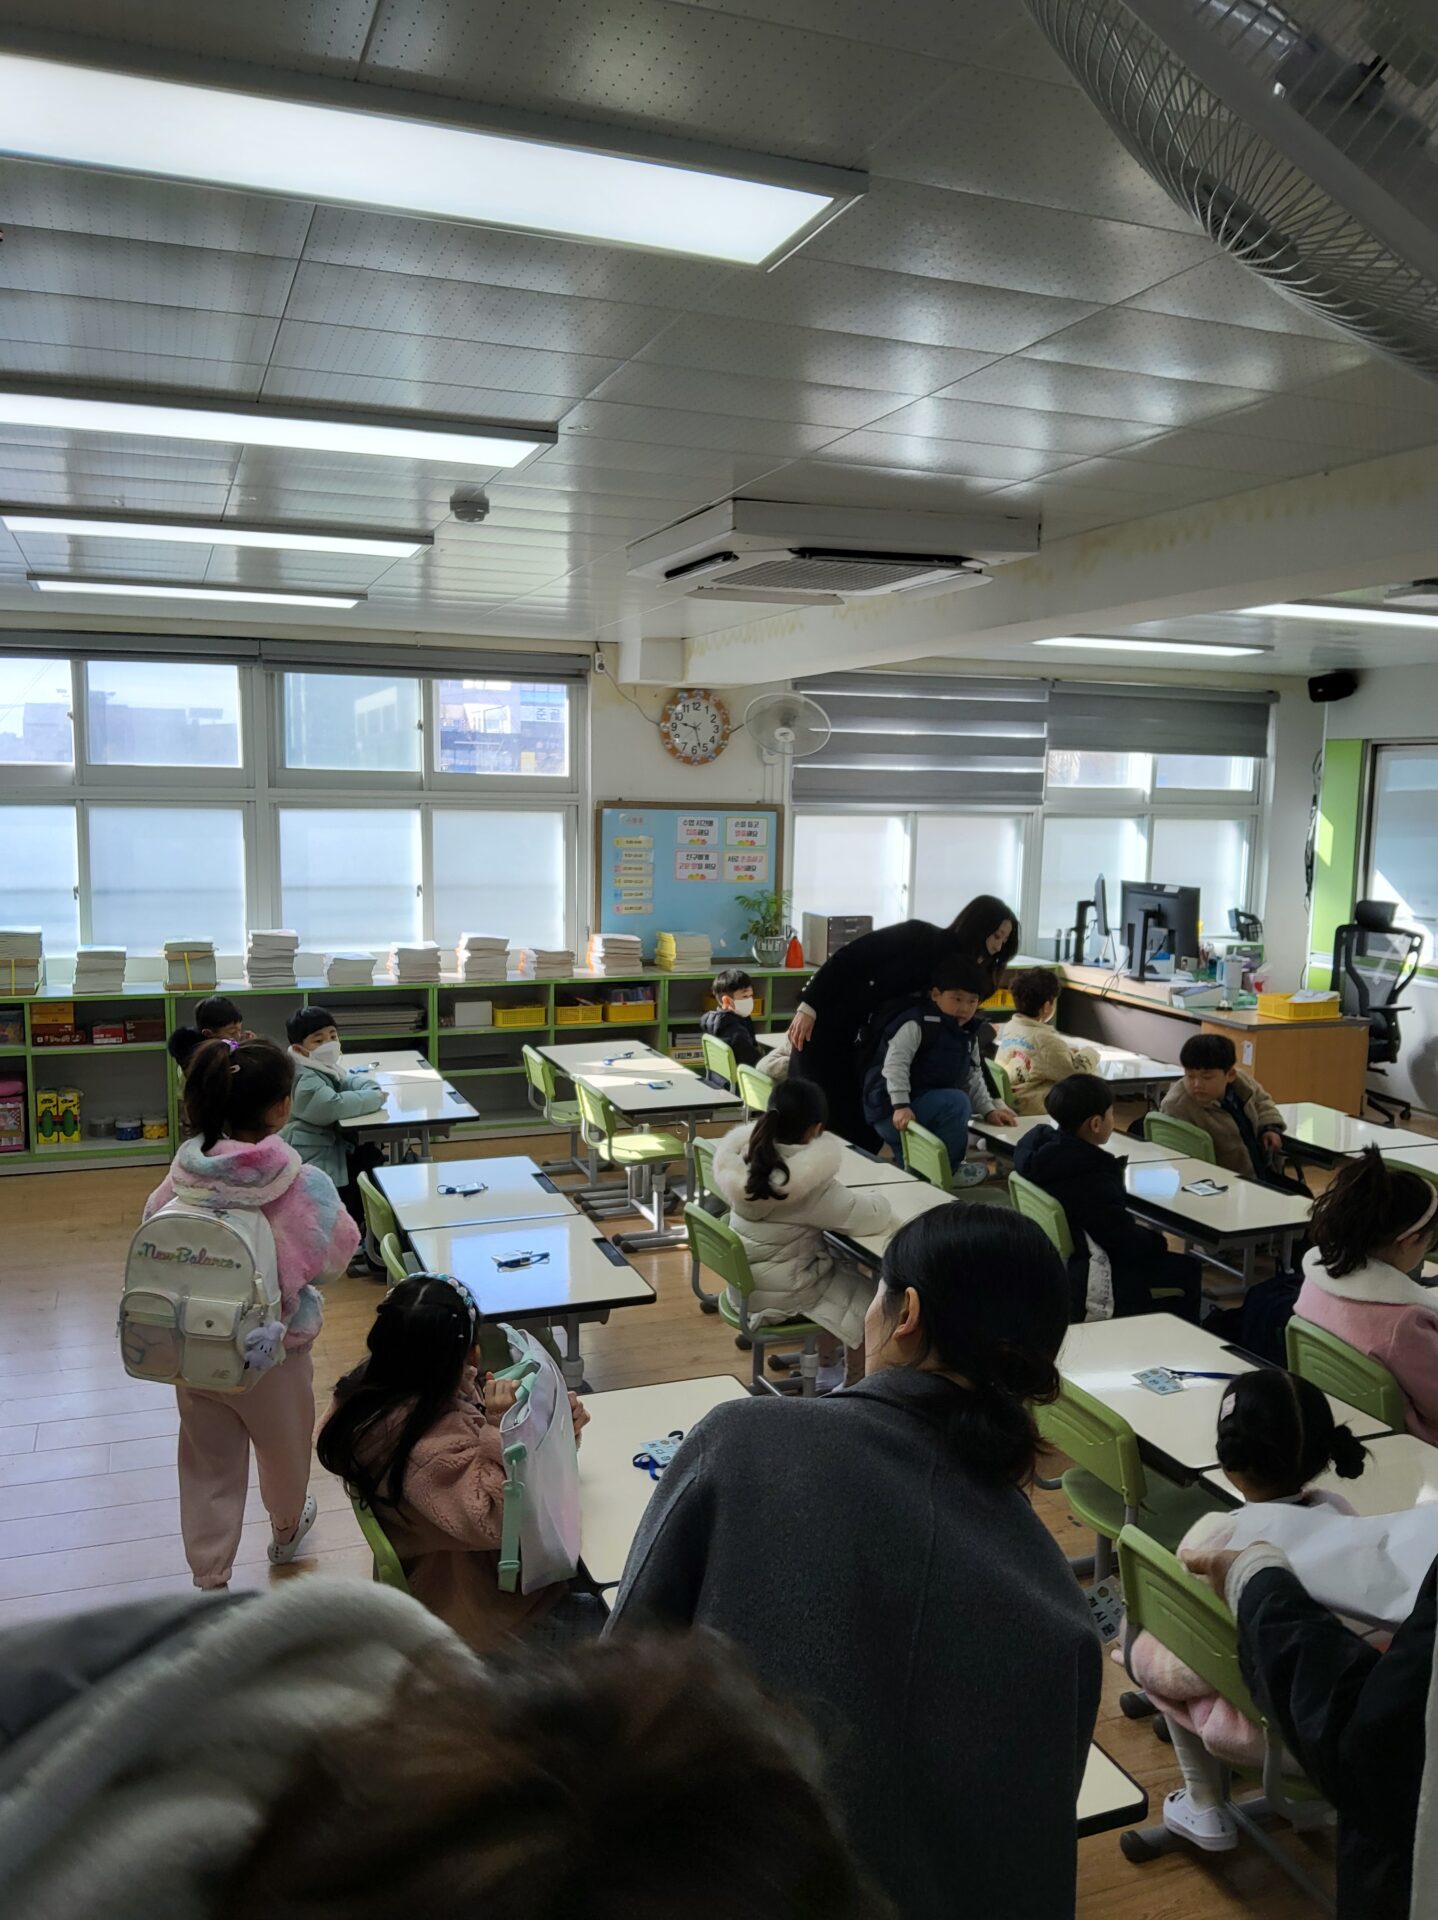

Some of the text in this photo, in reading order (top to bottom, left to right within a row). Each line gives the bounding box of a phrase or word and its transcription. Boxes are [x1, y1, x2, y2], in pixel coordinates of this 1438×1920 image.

[682, 704, 690, 713] 11
[692, 702, 701, 711] 12
[674, 712, 683, 721] 10
[710, 714, 717, 723] 2
[671, 722, 677, 731] 9
[713, 725, 720, 734] 3
[709, 736, 715, 744] 4
[681, 742, 688, 751] 7
[691, 745, 698, 755] 6
[702, 743, 709, 752] 5
[175, 1247, 234, 1269] Balance
